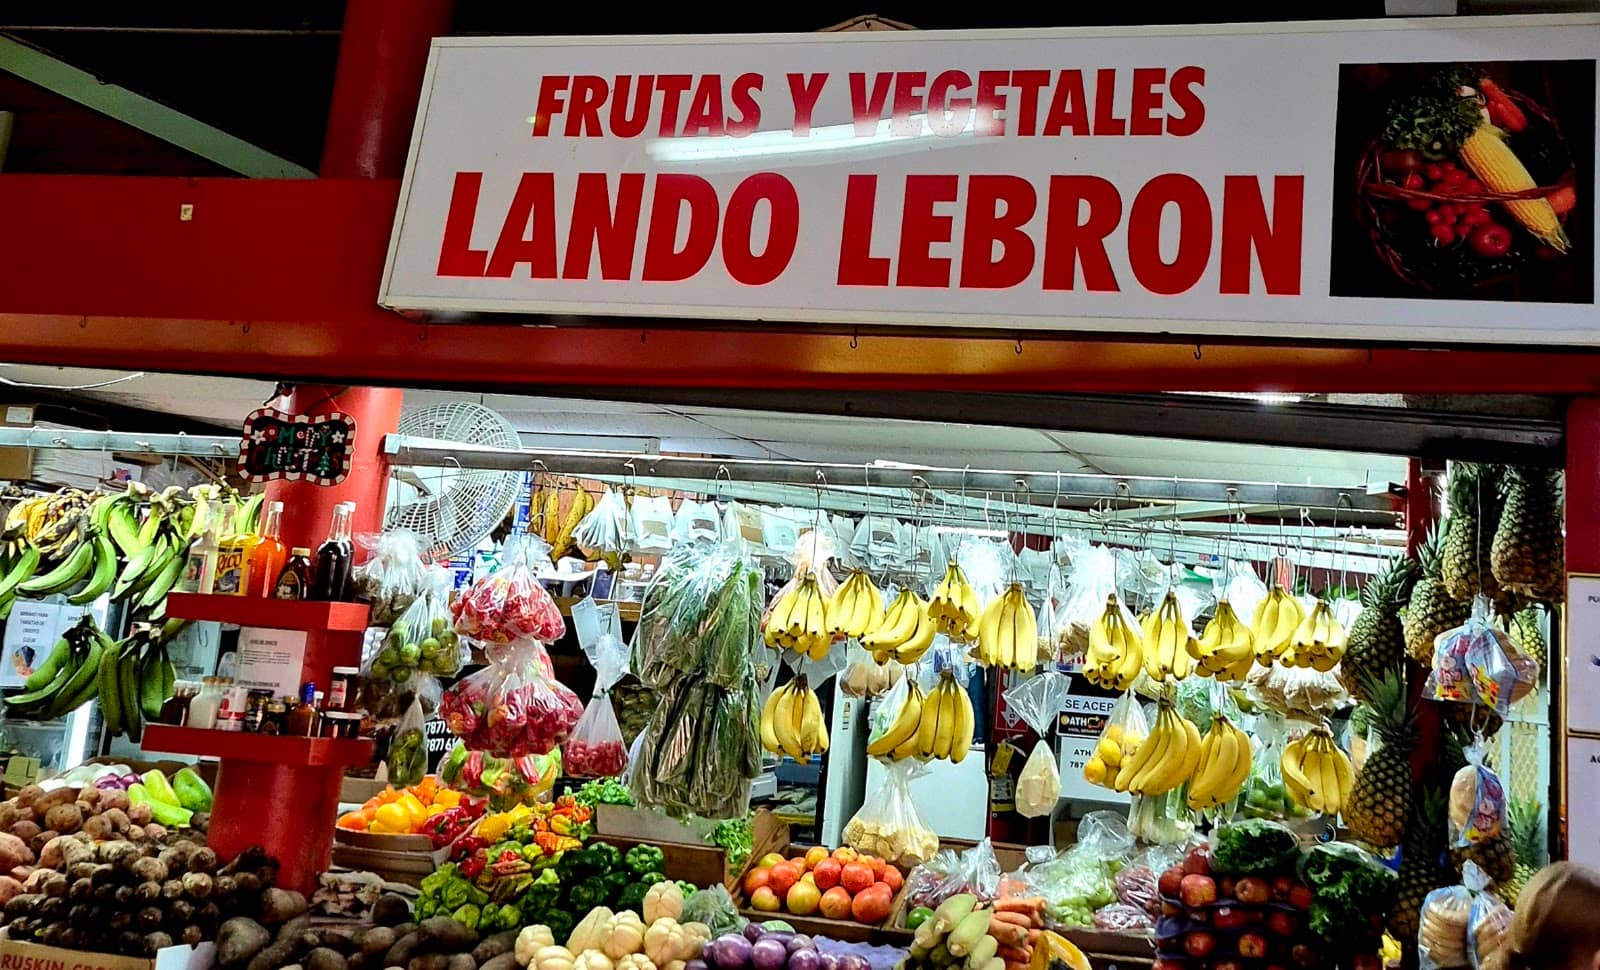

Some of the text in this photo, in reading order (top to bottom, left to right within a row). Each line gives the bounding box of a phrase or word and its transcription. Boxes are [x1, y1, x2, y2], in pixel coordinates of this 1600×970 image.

[532, 69, 1203, 139] FRUTAS Y VEGETALES
[436, 171, 1303, 297] LANDO LEBRON
[1064, 699, 1080, 709] SE
[1069, 716, 1087, 726] ATH
[1, 953, 65, 970] RUSKIN
